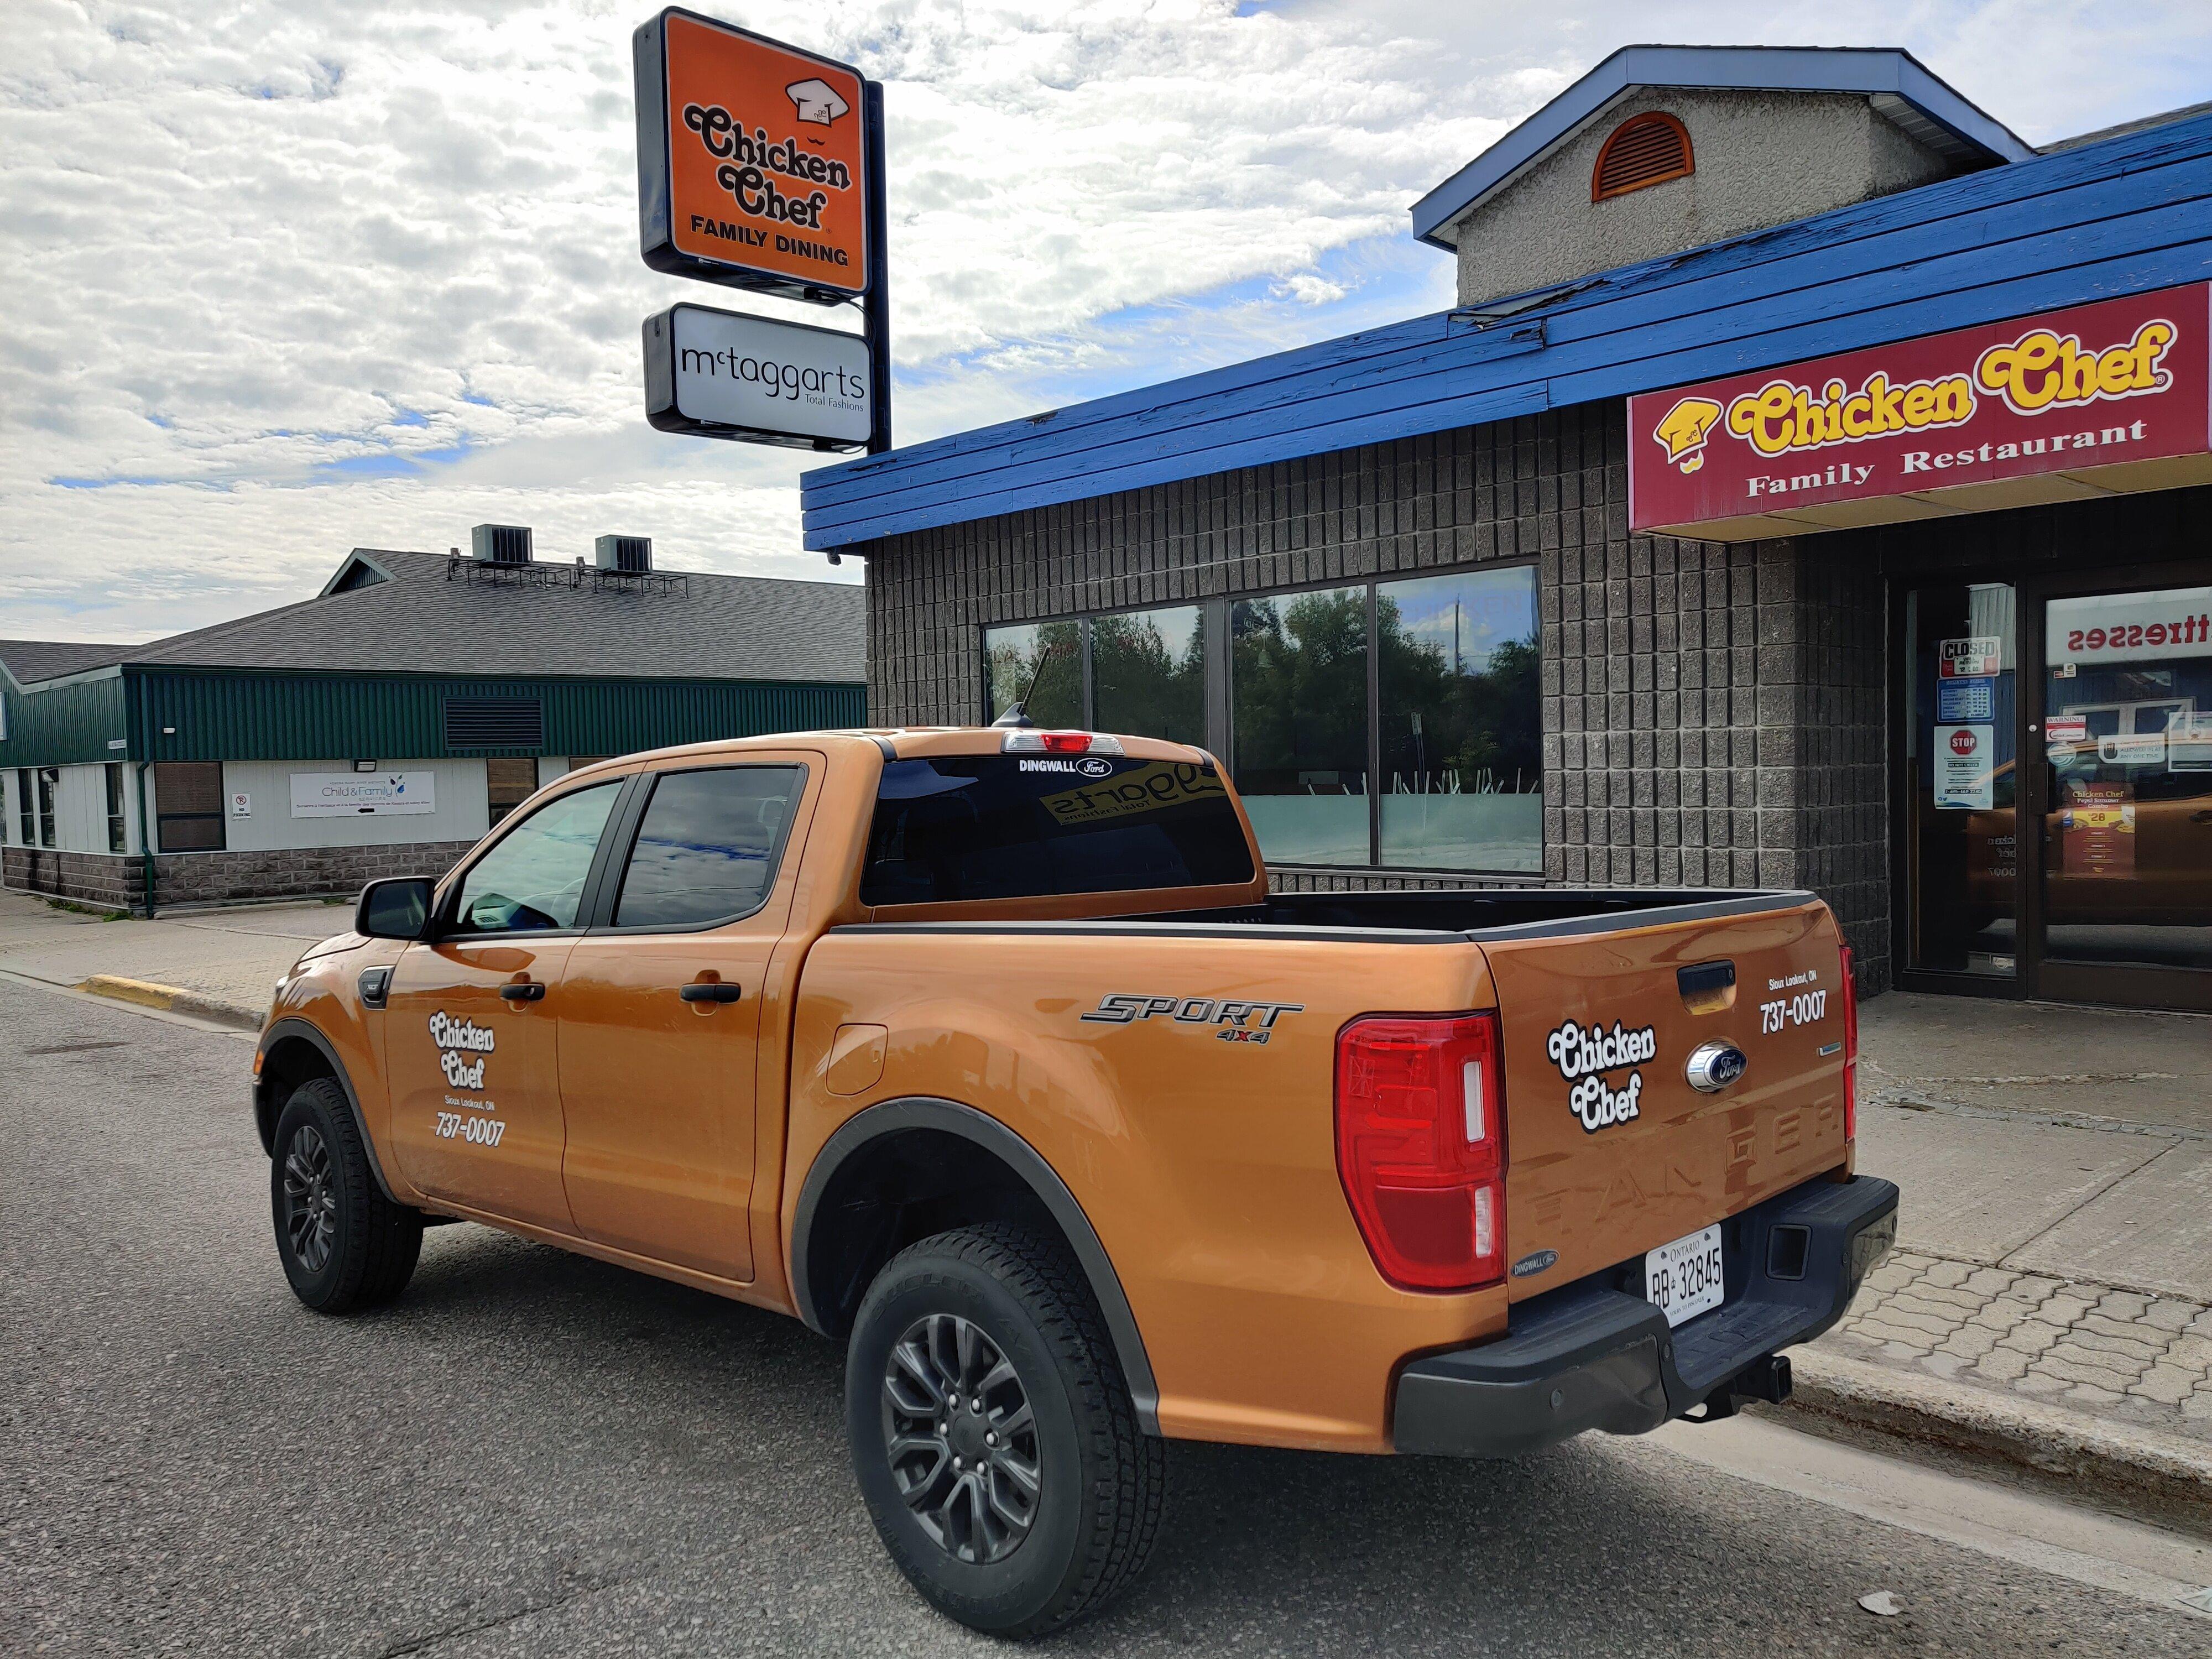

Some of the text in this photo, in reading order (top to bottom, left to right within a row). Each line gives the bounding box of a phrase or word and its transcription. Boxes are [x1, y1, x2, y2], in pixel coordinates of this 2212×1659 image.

[684, 103, 851, 190] Chicken
[719, 166, 825, 228] Chef
[691, 215, 849, 267] FAMILY DINING
[805, 394, 863, 412] Total Fashions
[1729, 323, 2174, 456] Chicken Chef
[1745, 420, 2148, 498] Family Restaurant
[1945, 641, 1995, 659] CLOSED
[1952, 737, 1975, 747] STOP
[1019, 759, 1076, 773] DINGWALL
[322, 787, 349, 796] Child
[359, 786, 392, 797] Family
[1769, 969, 1817, 991] Sioux Lookout, ON
[1080, 993, 1306, 1028] SPORT
[1760, 989, 1827, 1035] 737-0007
[430, 1011, 495, 1051] Chicken
[1548, 1021, 1656, 1079] Chicken
[1719, 1055, 1741, 1079] Ford
[441, 1050, 485, 1089] Chef
[486, 1101, 495, 1111] ON
[1570, 1071, 1642, 1131] Chef
[435, 1112, 506, 1147] 737-0007
[1514, 1256, 1543, 1275] DINGWALL
[1670, 1240, 1700, 1262] ONTARIO
[1679, 1248, 1720, 1300] 32845
